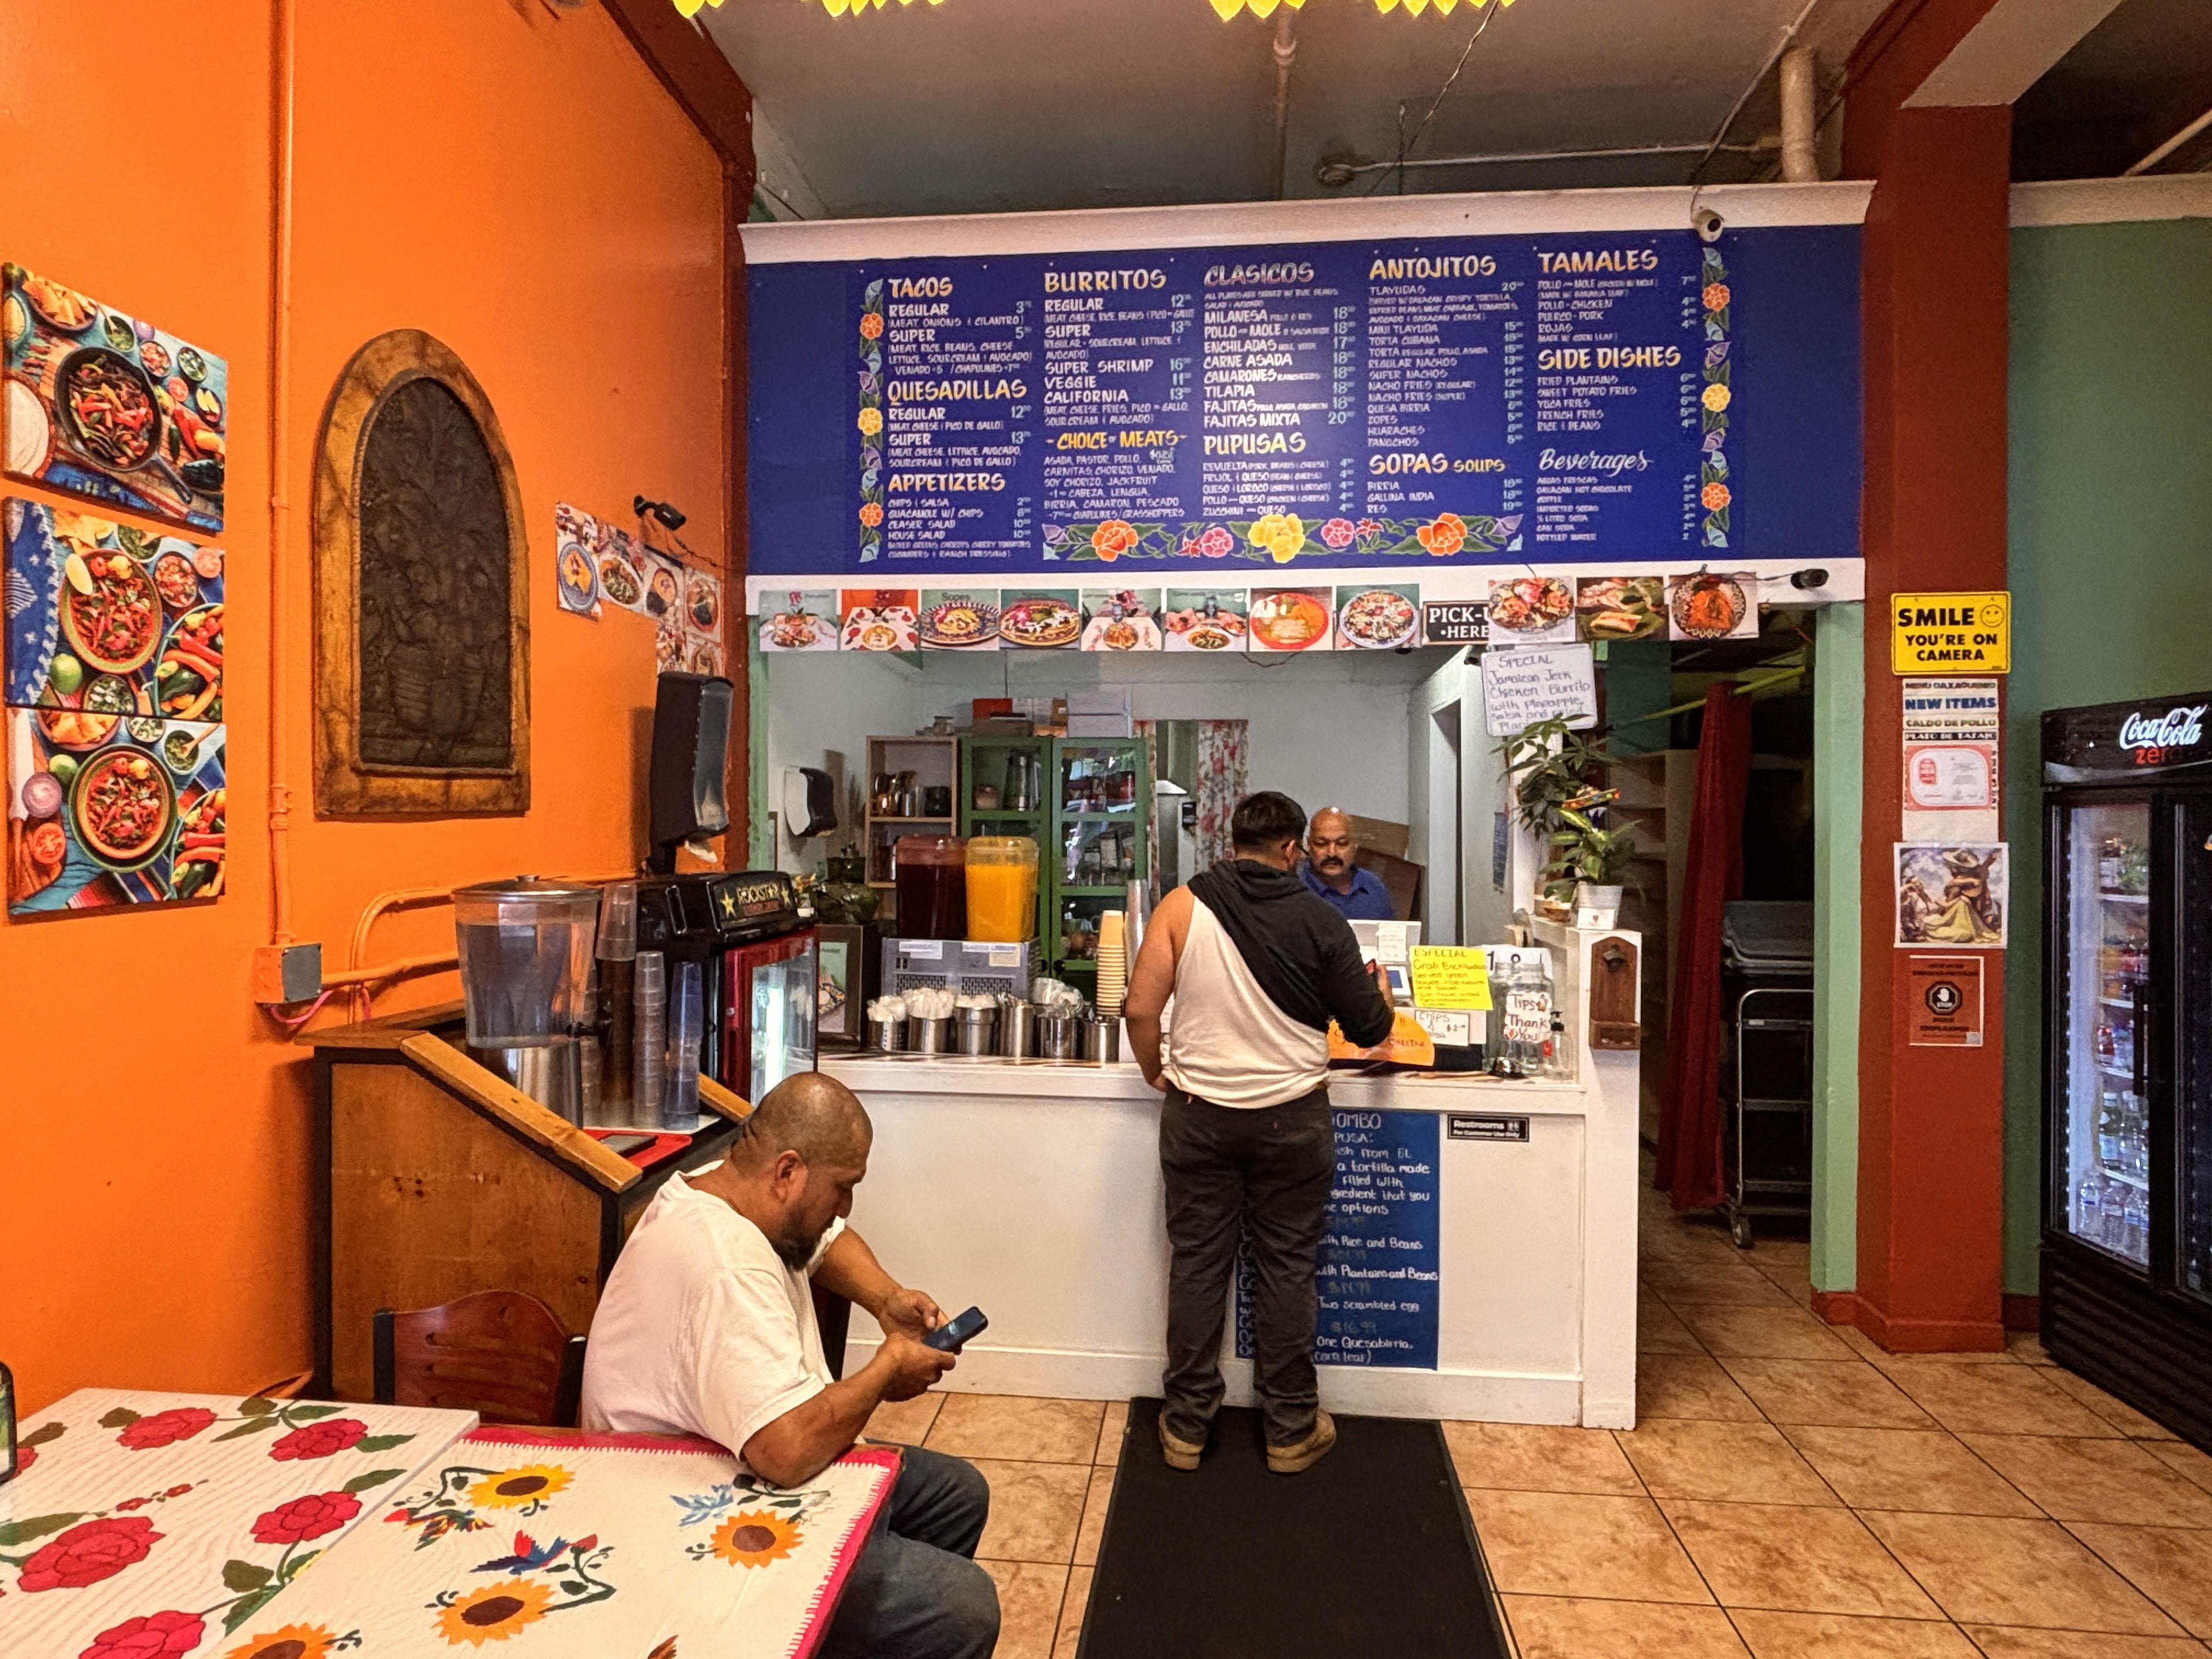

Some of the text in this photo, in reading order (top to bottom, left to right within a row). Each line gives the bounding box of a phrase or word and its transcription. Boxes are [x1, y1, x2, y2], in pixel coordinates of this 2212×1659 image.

[1369, 255, 1496, 280] ANTOJITOS
[1538, 249, 1658, 273] TAMALES
[1045, 269, 1166, 292] BURRITOS
[1205, 262, 1314, 286] CLASICOS
[888, 276, 953, 298] TACOS
[1370, 285, 1426, 296] TLAYUDAS
[889, 303, 949, 317] REGULAR
[1045, 298, 1104, 312] REGULAR
[1538, 299, 1612, 311] POLLO CHICKEN
[1205, 309, 1267, 324] MILANESA
[1538, 311, 1604, 322] PUERCO PORK
[1045, 324, 1091, 337] SUPER
[1205, 326, 1237, 339] POLLO
[1250, 324, 1281, 337] MOLE
[1393, 324, 1438, 334] TLAYUDA
[1538, 323, 1573, 334] ROJAS
[889, 329, 935, 342] SUPER
[1205, 339, 1277, 353] ENCHILADAS
[1204, 353, 1293, 369] CARNE ASADA
[1368, 358, 1457, 369] REGULAR NACHOS
[1538, 346, 1681, 370] SIDE DISHES
[1045, 359, 1153, 374] SUPER SHRIMP
[1204, 368, 1277, 384] CAMARONES
[1369, 369, 1448, 380] SUPER NACHOS
[1566, 375, 1618, 385] PLANTAINS
[1045, 375, 1097, 389] VEGGIE
[1368, 381, 1432, 391] NACHO FRIES
[888, 379, 1027, 405] QUESADILLAS
[1044, 390, 1128, 404] CALIFORNIA
[1204, 384, 1255, 398] TILAPIA
[1368, 392, 1432, 402] NACHO FRIES
[1573, 387, 1606, 397] POTATO
[1610, 387, 1637, 396] FRIES
[1204, 399, 1256, 413] FAJITAS
[1564, 399, 1590, 408] FRIES
[889, 407, 946, 420] REGULAR
[1538, 410, 1604, 420] FRENCH FRIES
[1204, 413, 1300, 428] FAJITAS MIXTA
[1538, 421, 1600, 431] RICE BEANS
[1368, 426, 1425, 436] HUARACHES
[889, 433, 932, 446] SUPER
[1057, 430, 1178, 450] CHOICE MEATS
[1203, 432, 1306, 455] PUPUSAS
[1369, 453, 1505, 475] SOPAS SOUPS
[1539, 448, 1655, 477] Beverages
[888, 473, 1005, 492] APPETIZERS
[1107, 476, 1158, 486] JACKFRUIT
[1242, 472, 1269, 482] QUESO
[1203, 484, 1229, 494] QUESO
[921, 498, 949, 507] SALSA
[1203, 495, 1227, 505] POLLO
[958, 509, 984, 518] CHIPS
[1257, 505, 1285, 514] QUESO
[928, 520, 955, 528] SALAD
[888, 531, 945, 539] HOUSE SALAD
[1898, 607, 1974, 627] SMILE
[1905, 633, 1997, 646] YOU'RE ON
[1498, 654, 1553, 668] SPECIAL
[1916, 649, 1984, 662] CAMERA
[1488, 669, 1571, 685] Jamaican Jerk
[1491, 680, 1590, 698] Chicken Burrito
[1491, 701, 1519, 711] with
[1905, 697, 1996, 709] NEW ITEMS
[1527, 709, 1548, 719] and
[2119, 704, 2209, 750] Coca-Cola
[2135, 747, 2183, 765] zero
[1414, 948, 1466, 957] ESPECIAL
[1508, 994, 1534, 1011] Tips
[1507, 1014, 1547, 1028] Thank
[1519, 1028, 1539, 1041] You
[1332, 1113, 1381, 1130] OMBO
[1454, 1120, 1504, 1129] Restrooms
[1352, 1160, 1395, 1172] tortilla
[1383, 1190, 1430, 1201] that you
[1341, 1202, 1389, 1215] options
[1341, 1235, 1423, 1249] Rice and Beans
[1408, 1267, 1438, 1280] Beans
[1344, 1301, 1396, 1311] scrambled
[1317, 1336, 1338, 1346] One
